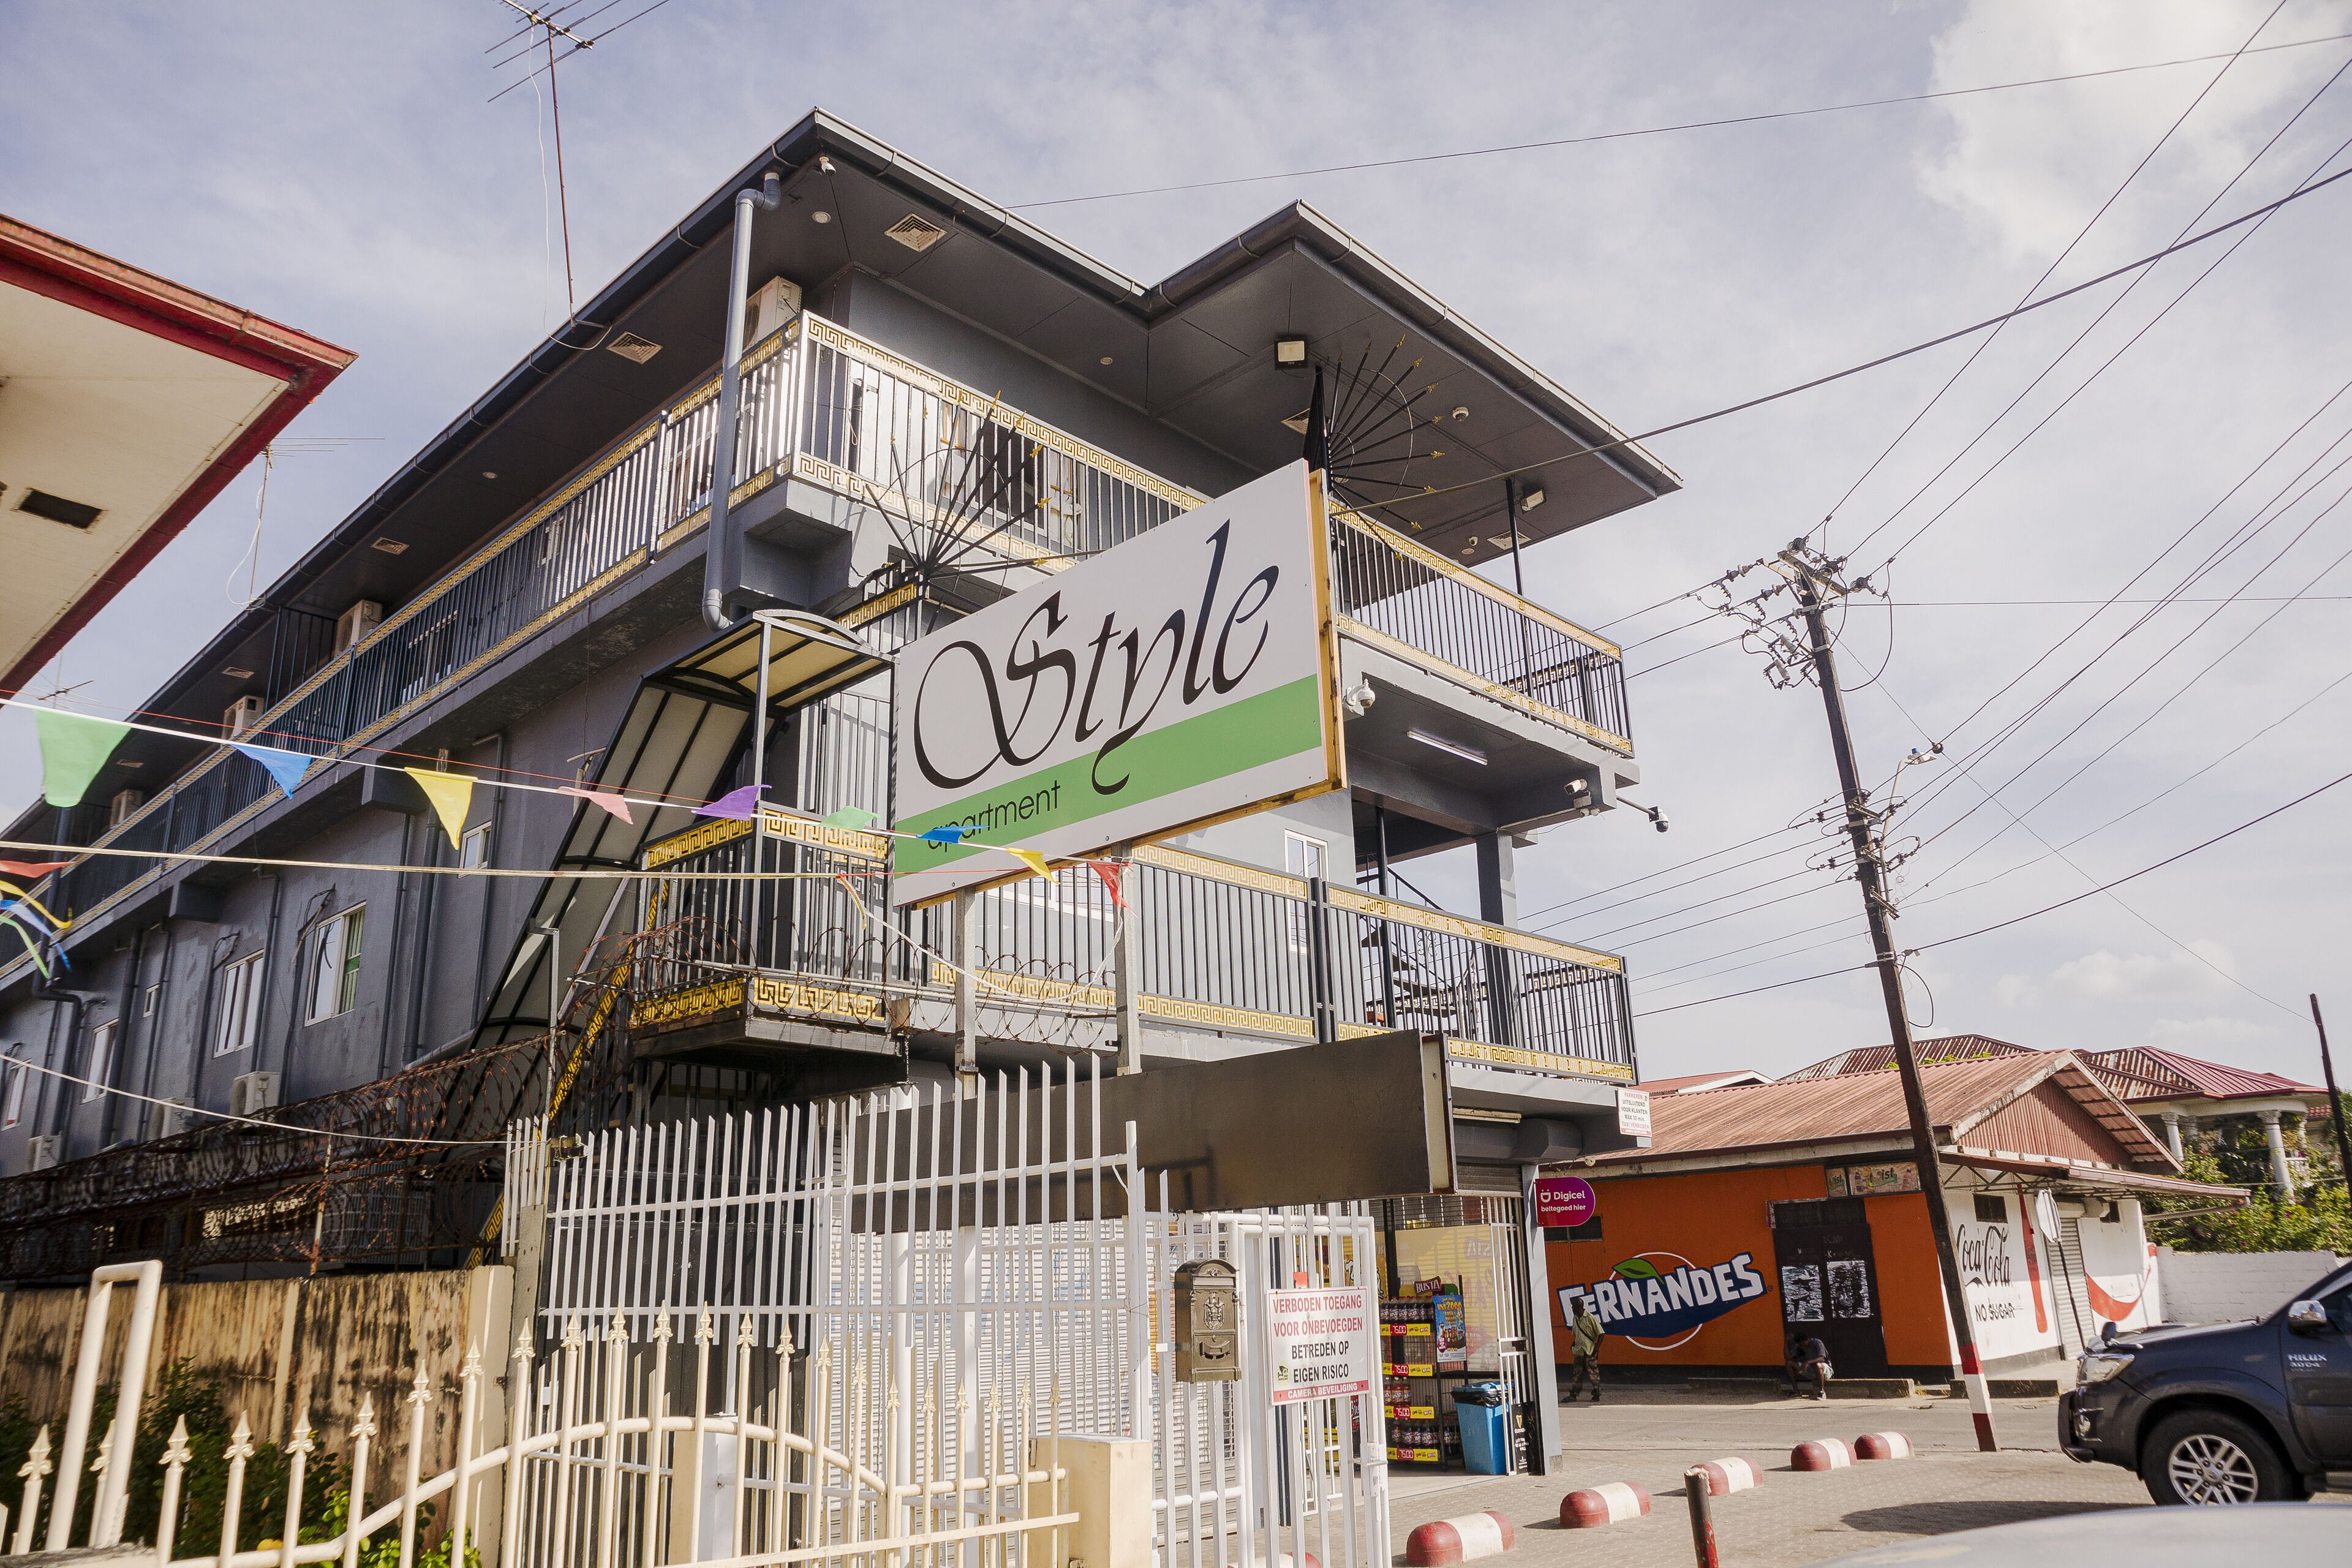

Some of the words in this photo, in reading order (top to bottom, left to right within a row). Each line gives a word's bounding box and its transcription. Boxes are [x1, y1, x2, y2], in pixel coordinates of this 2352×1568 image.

[914, 519, 1279, 795] Style
[1553, 1190, 1586, 1202] Digicel
[1415, 1279, 1440, 1294] BUSTA
[1559, 1253, 1764, 1328] FERNANDES
[1273, 1297, 1321, 1314] VERBODEN
[1324, 1295, 1362, 1311] TOEGANG
[1975, 1303, 1987, 1322] NO
[1988, 1302, 2015, 1321] SUGAR
[1274, 1321, 1299, 1337] VOOR
[1302, 1317, 1363, 1335] ONBEVOEGDEN
[1292, 1342, 1336, 1360] BETREDEN
[1339, 1341, 1349, 1355] OP
[1294, 1367, 1319, 1383] EIGEN
[1322, 1363, 1349, 1379] RISICO
[1287, 1387, 1317, 1399] CAMERA
[1318, 1382, 1358, 1396] BEVEILIGING
